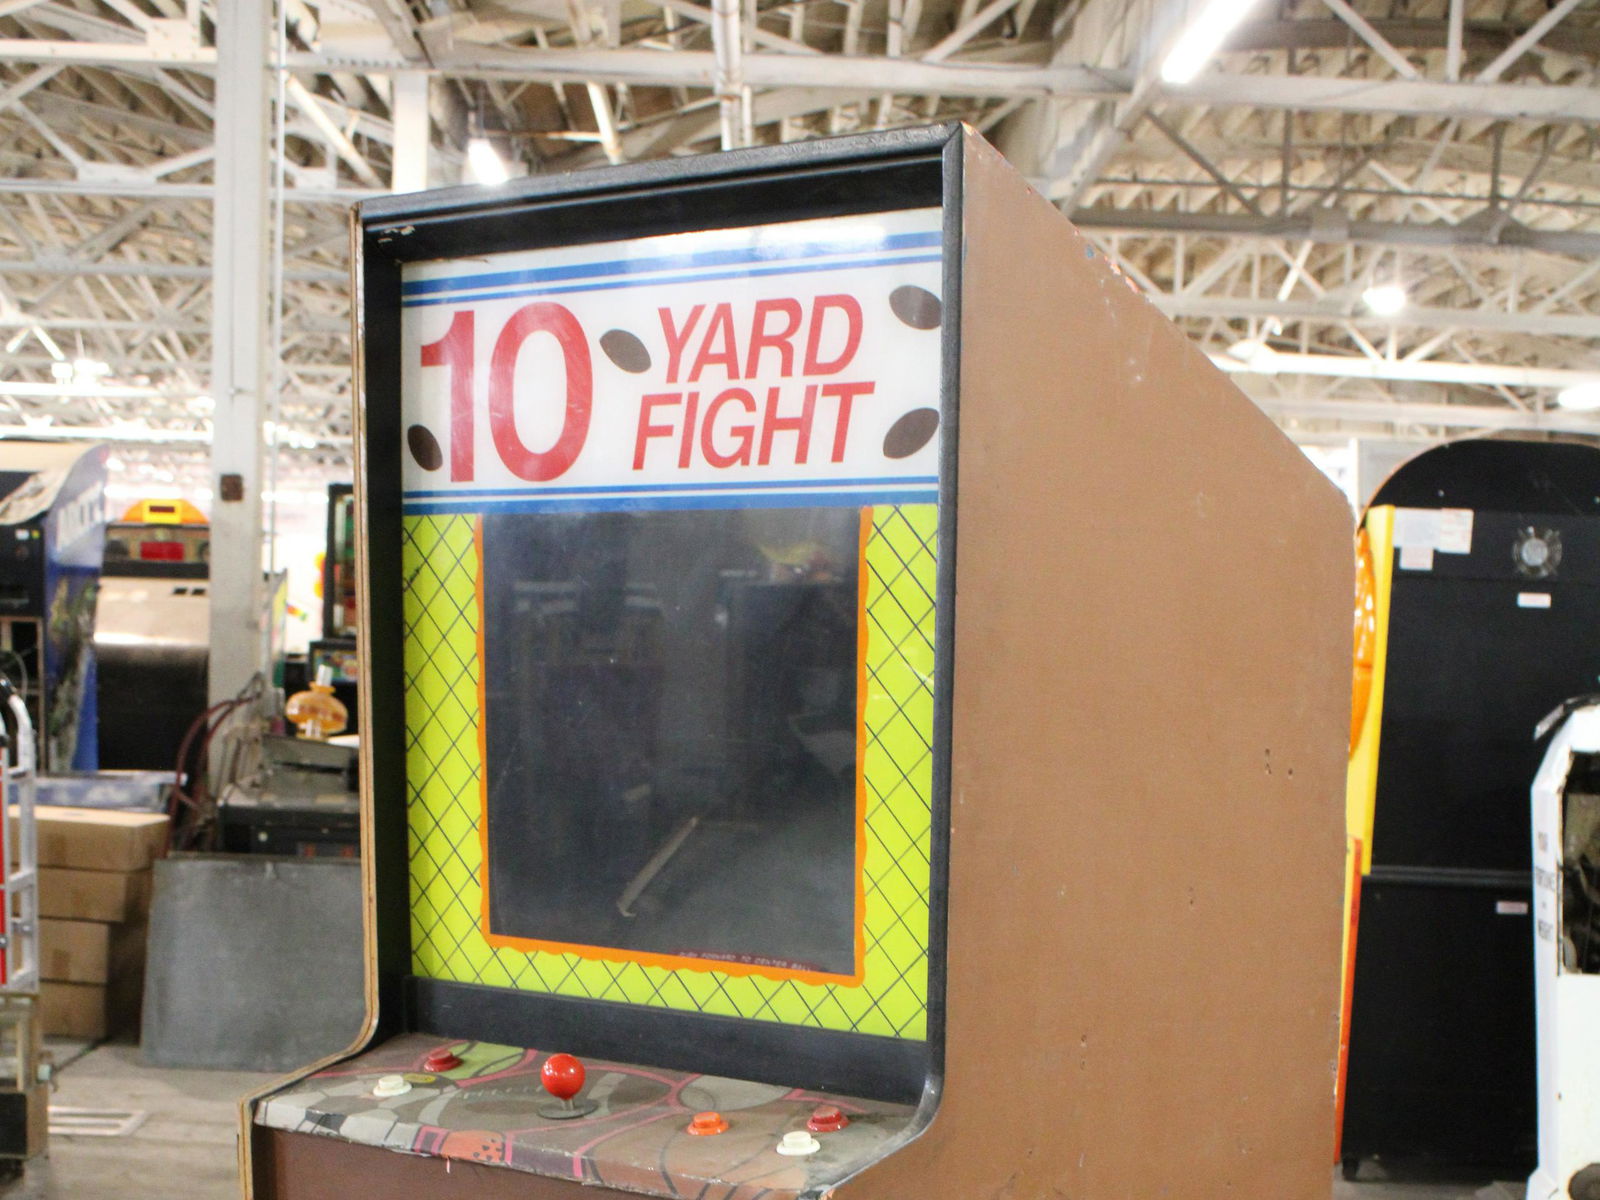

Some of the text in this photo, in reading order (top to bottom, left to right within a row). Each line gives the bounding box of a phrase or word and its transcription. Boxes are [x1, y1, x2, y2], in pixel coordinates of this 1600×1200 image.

[658, 294, 863, 383] YARD
[421, 302, 593, 483] 10
[632, 382, 875, 471] FIGHT
